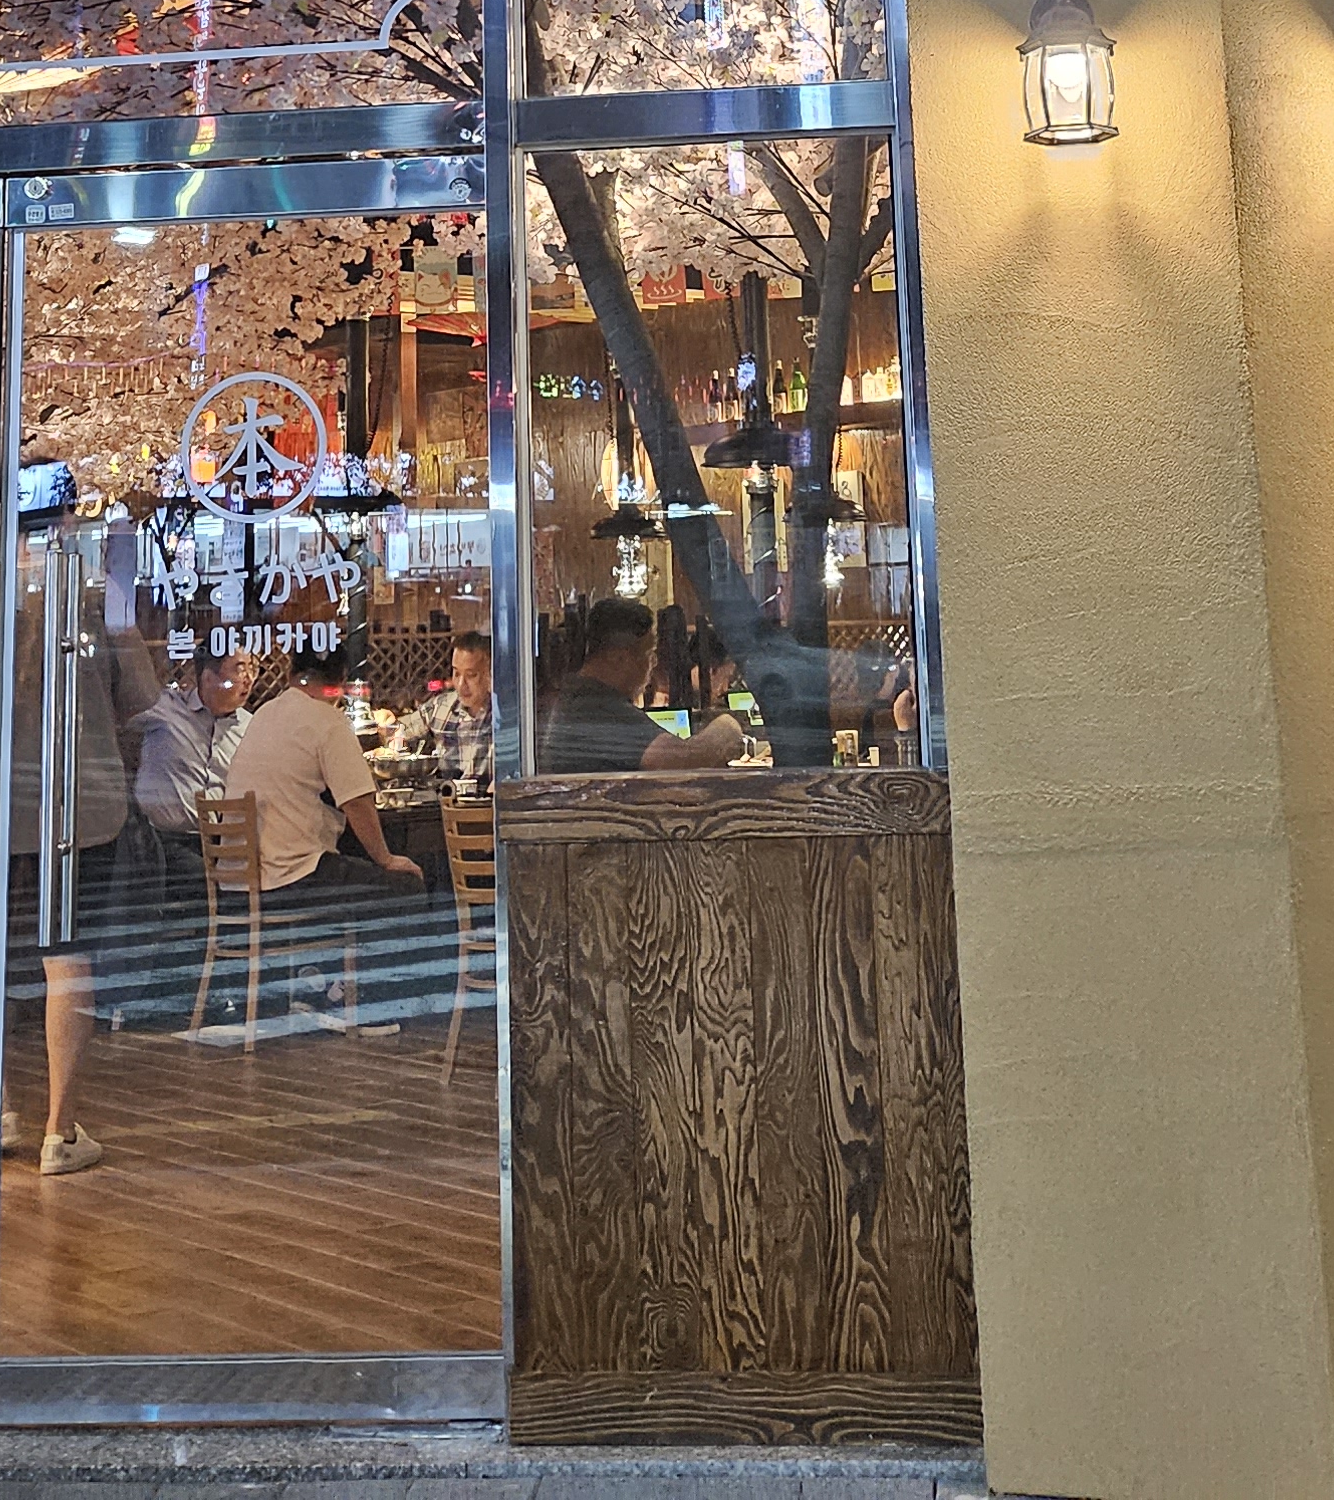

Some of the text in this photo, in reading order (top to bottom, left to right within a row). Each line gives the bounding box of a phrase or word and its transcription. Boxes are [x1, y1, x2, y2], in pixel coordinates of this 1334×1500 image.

[215, 397, 304, 498] 本
[151, 551, 362, 611] やきかや
[167, 620, 342, 660] 본 야끼카야
